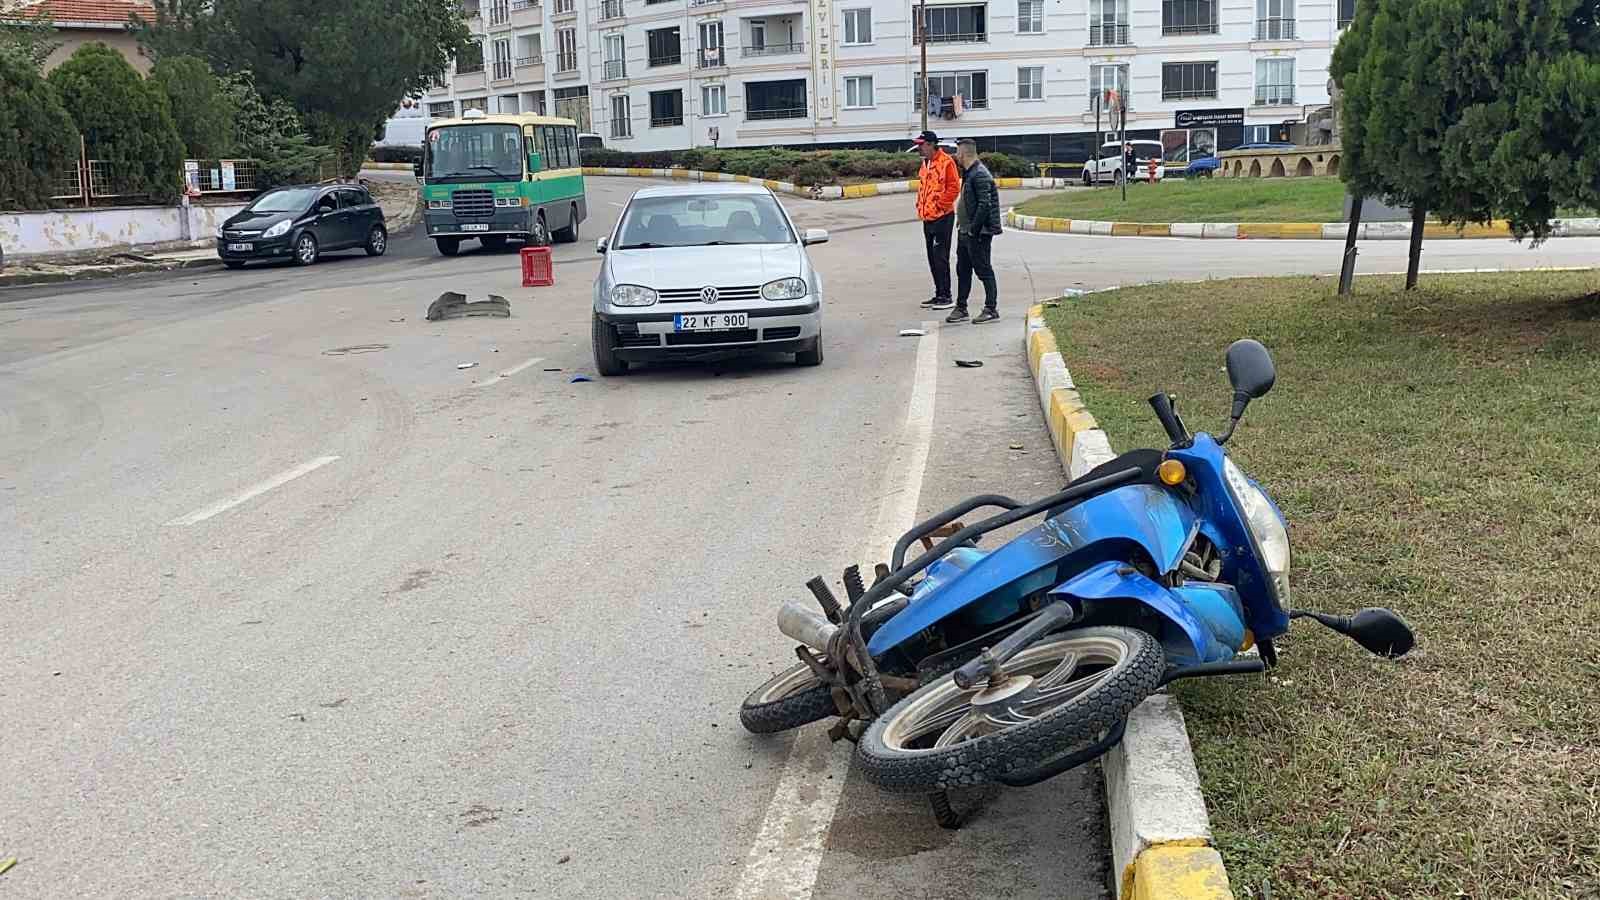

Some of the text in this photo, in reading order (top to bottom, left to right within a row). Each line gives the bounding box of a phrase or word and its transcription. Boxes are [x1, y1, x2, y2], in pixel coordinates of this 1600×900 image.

[683, 317, 697, 328] 22
[703, 315, 717, 328] KF
[723, 314, 745, 327] 900
